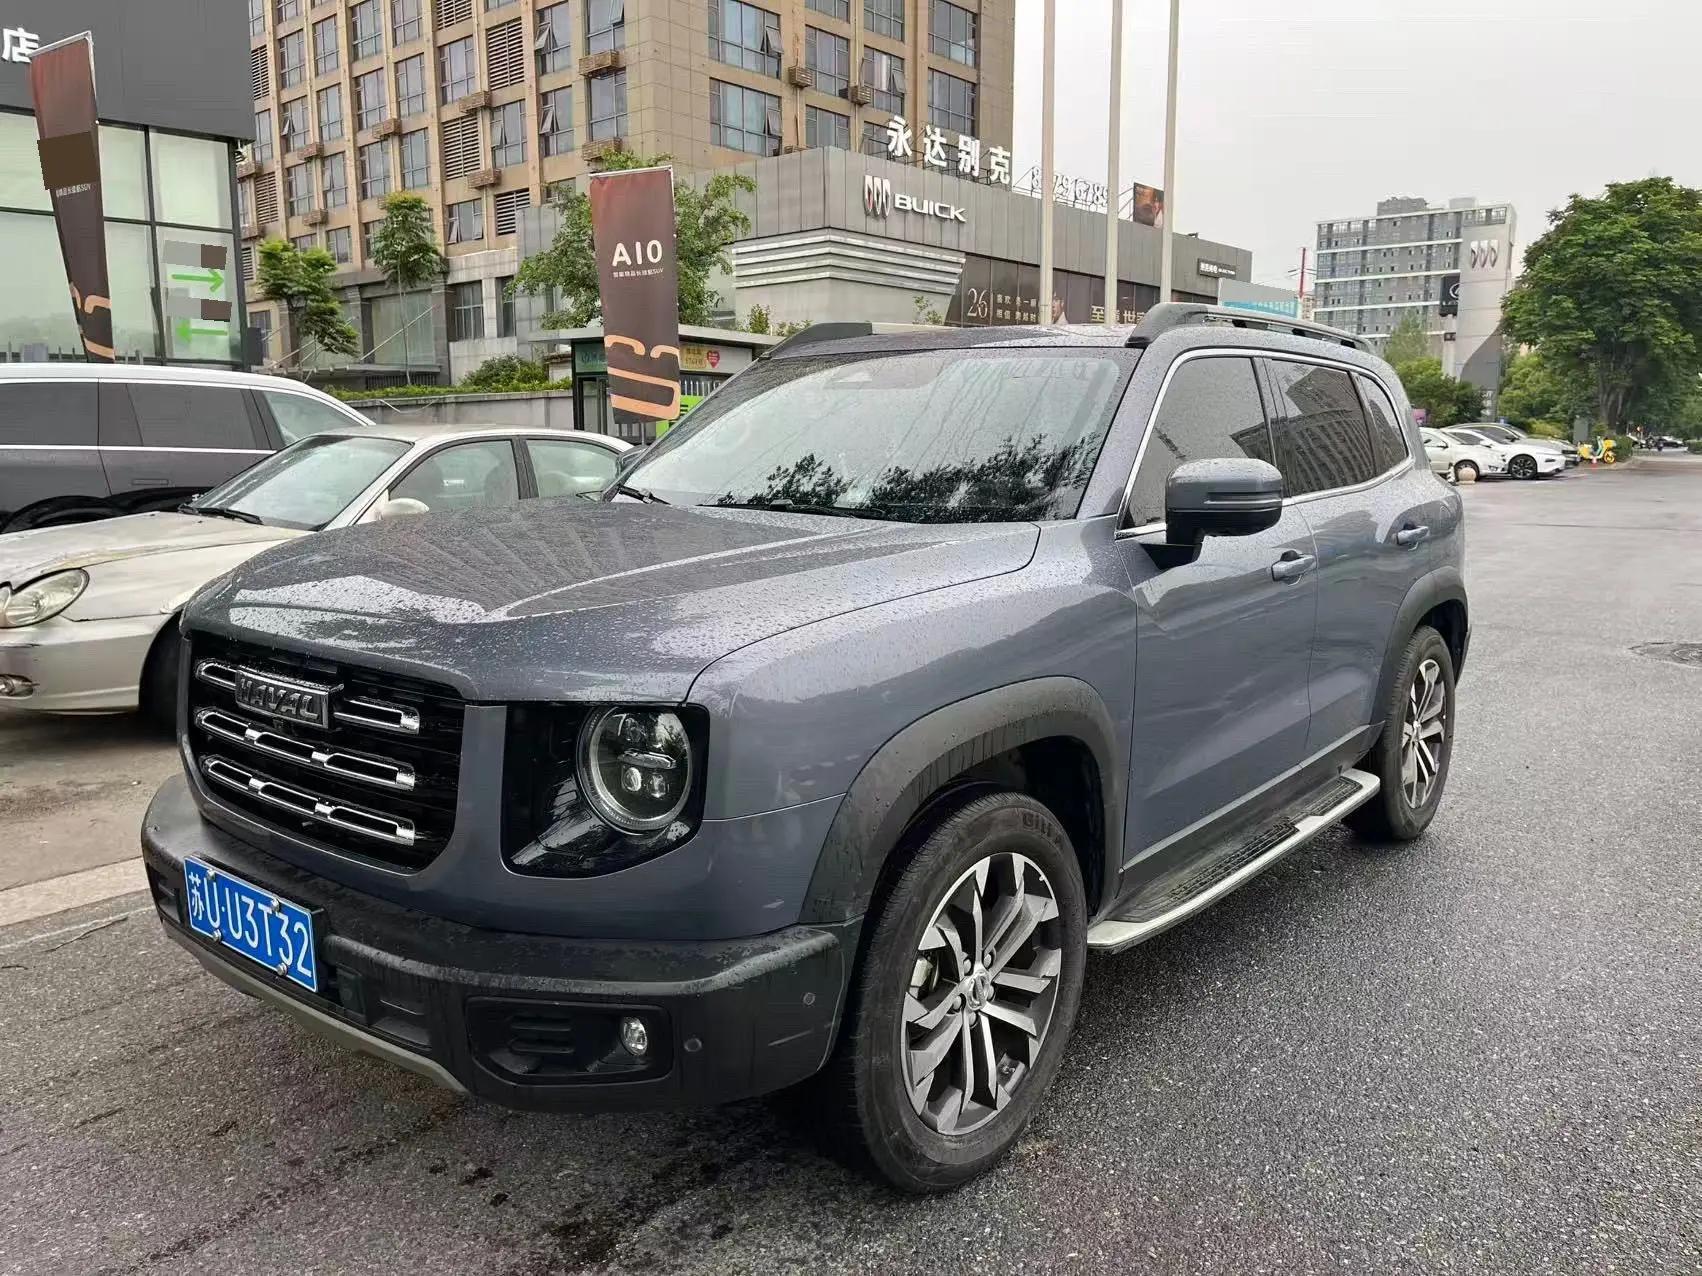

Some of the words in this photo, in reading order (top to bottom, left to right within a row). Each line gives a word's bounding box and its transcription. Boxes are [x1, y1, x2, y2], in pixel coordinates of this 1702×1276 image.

[1, 27, 40, 64] 店
[886, 115, 1012, 185] 永达别克
[894, 193, 967, 223] BUICK
[967, 287, 989, 319] 26
[240, 678, 319, 720] HAVAL
[189, 871, 313, 978] 苏U·U3T32
